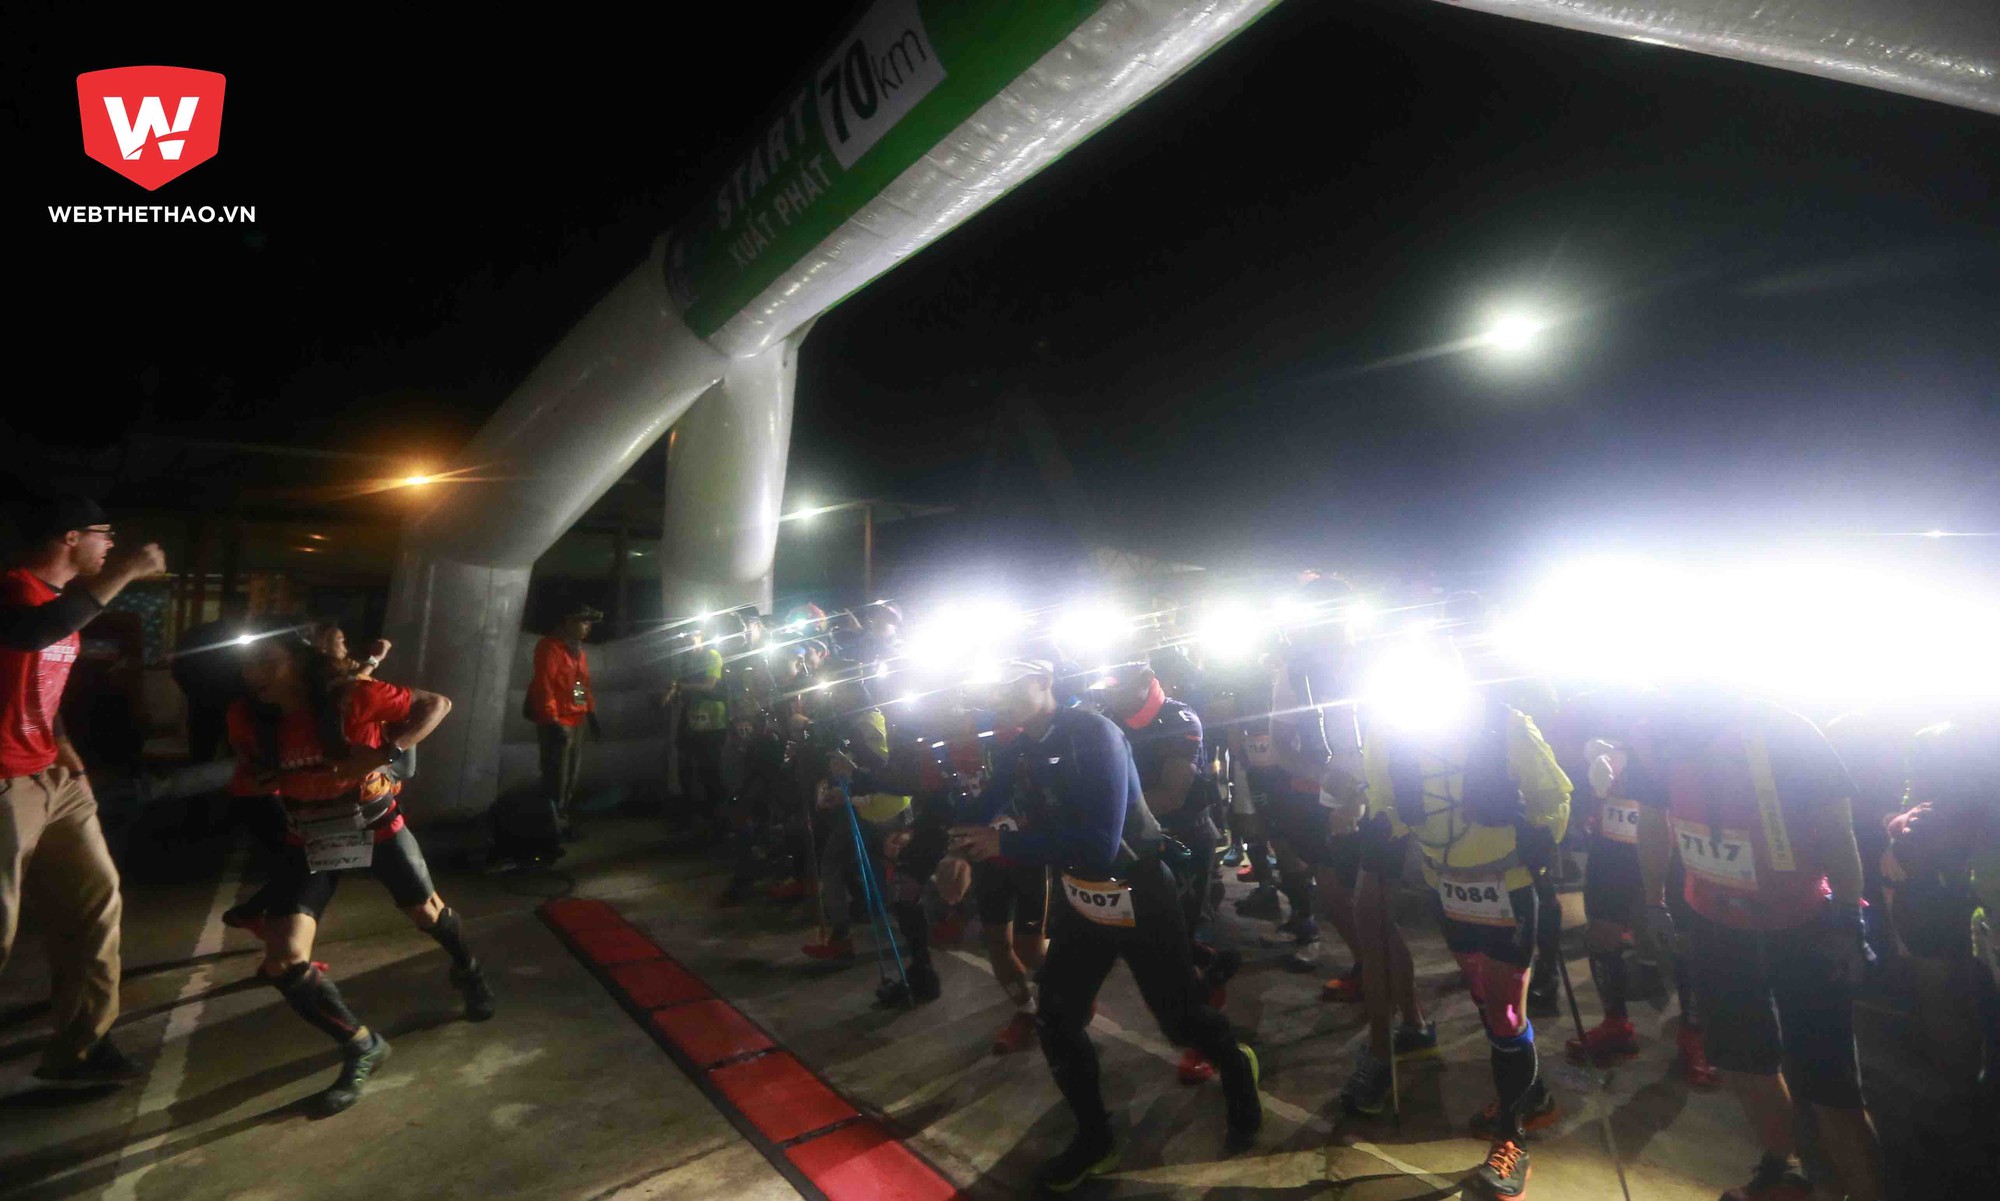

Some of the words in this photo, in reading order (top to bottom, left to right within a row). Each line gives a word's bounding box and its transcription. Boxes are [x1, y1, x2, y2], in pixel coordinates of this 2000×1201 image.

[716, 86, 806, 230] START
[1068, 884, 1121, 907] 7007
[1443, 882, 1499, 903] 7084
